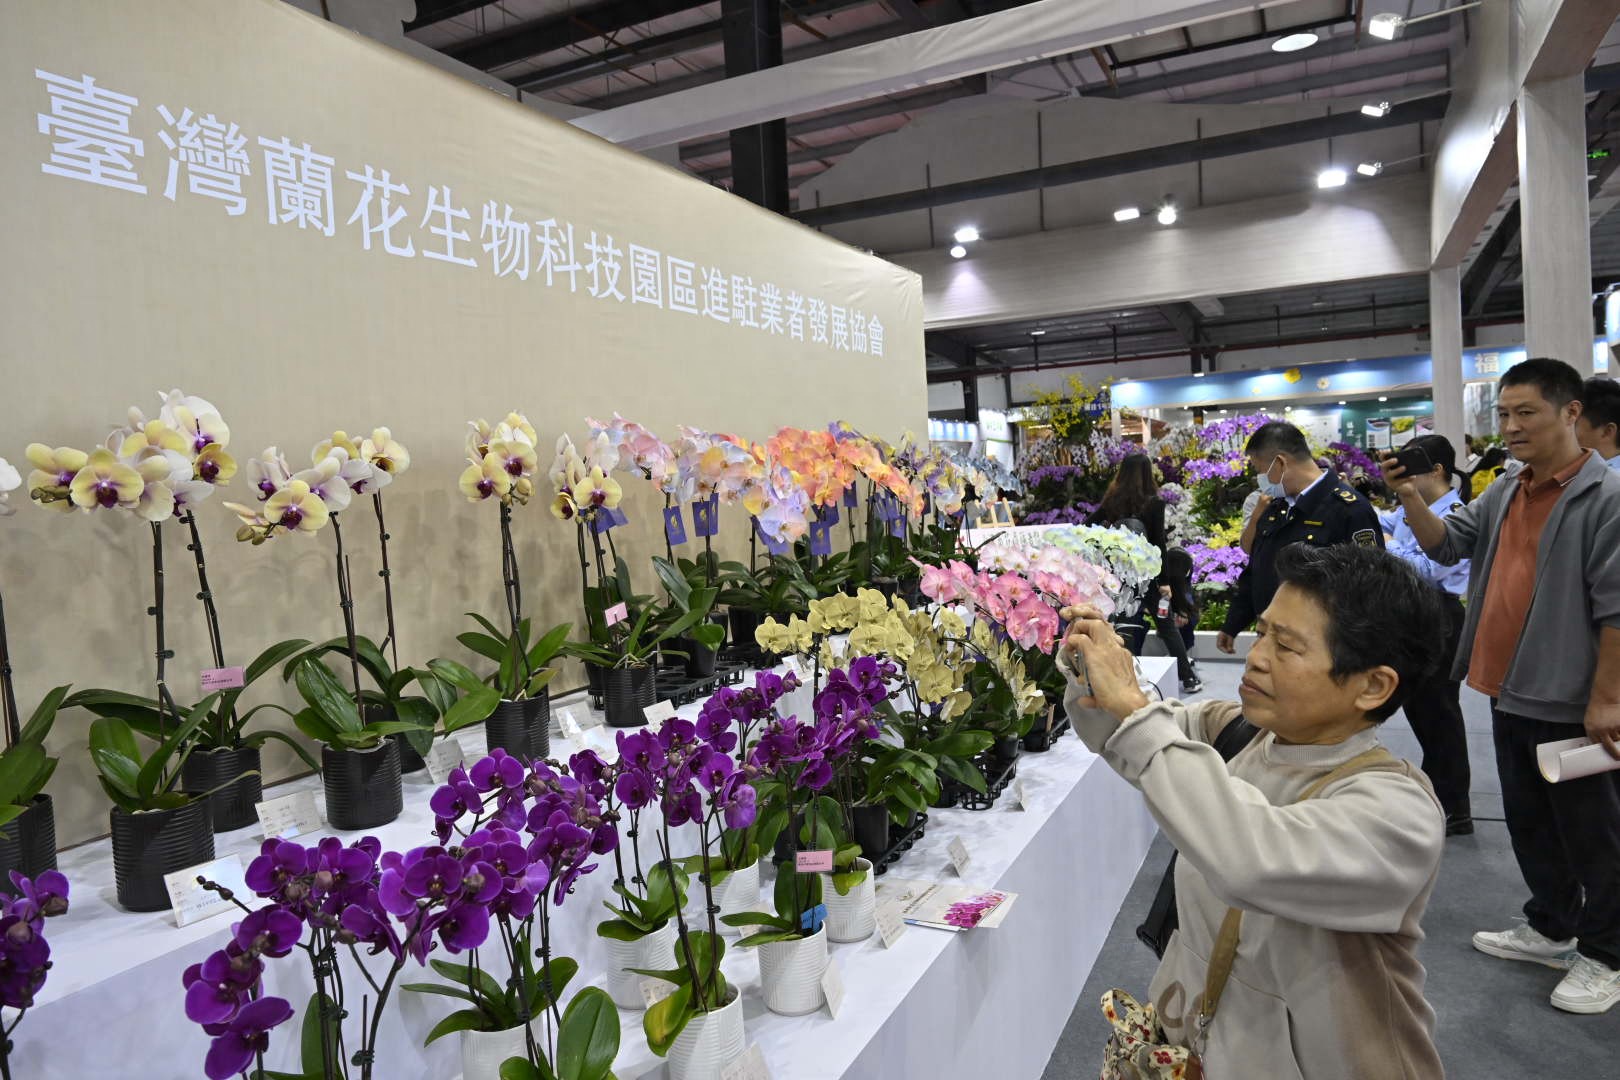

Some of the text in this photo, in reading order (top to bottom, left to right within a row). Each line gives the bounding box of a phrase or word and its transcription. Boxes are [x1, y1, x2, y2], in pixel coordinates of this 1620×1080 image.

[35, 68, 884, 357] 臺灣蘭花生物科技園區進駐業者發展協會
[1474, 352, 1500, 374] 福
